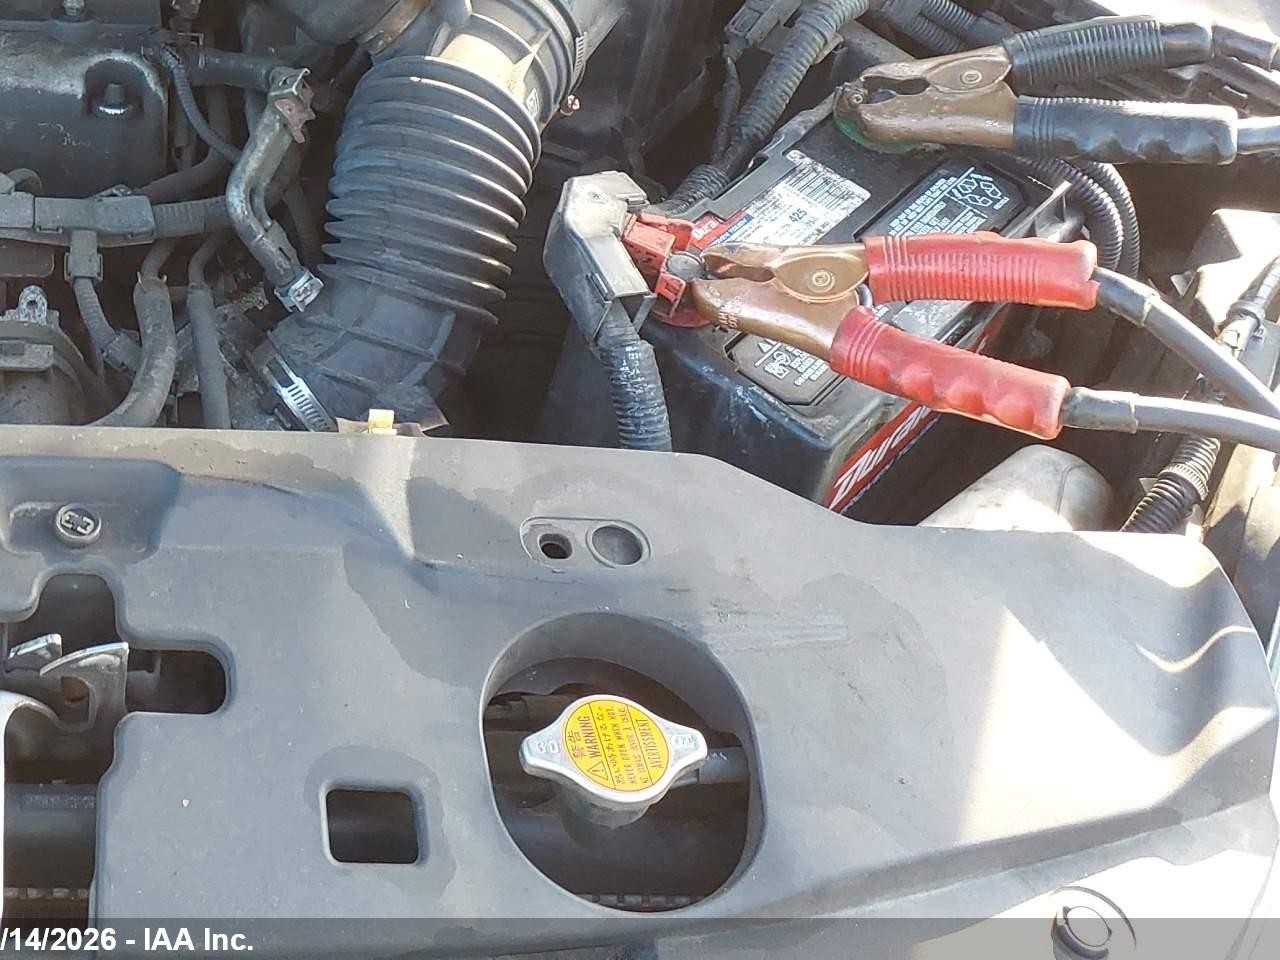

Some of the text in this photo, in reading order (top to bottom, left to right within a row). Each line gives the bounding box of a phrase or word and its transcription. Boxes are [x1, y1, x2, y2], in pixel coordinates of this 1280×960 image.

[788, 208, 808, 225] 425
[577, 715, 602, 759] WARNING
[606, 706, 638, 784] NEVER OPEN WHEN HOT.
